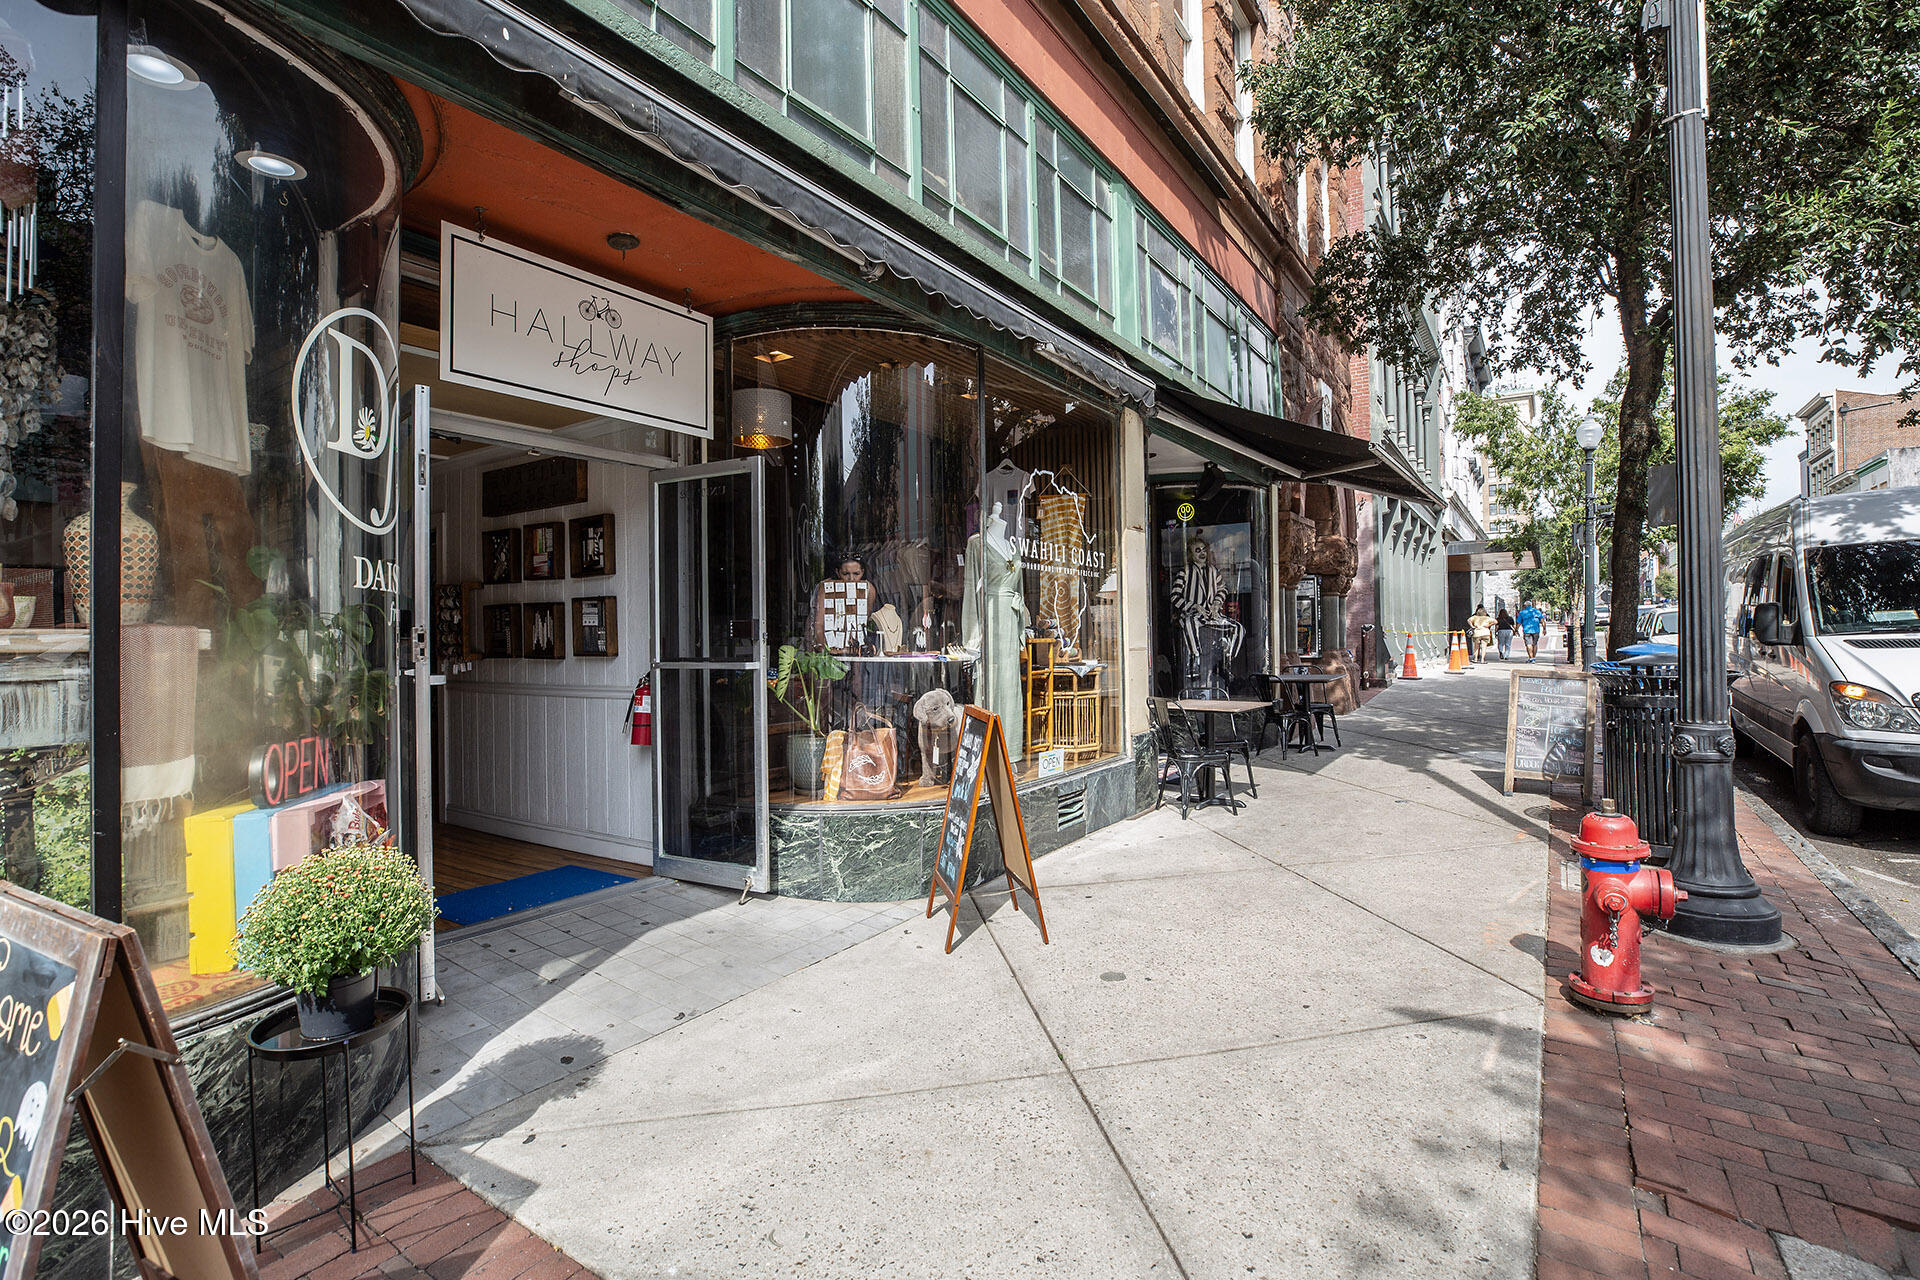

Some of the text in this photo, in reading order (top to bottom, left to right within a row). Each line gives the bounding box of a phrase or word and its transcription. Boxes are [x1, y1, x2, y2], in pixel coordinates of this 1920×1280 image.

[491, 293, 682, 377] HALLWAY
[552, 338, 643, 397] shops
[1009, 535, 1105, 569] SWAHILI COAST
[263, 736, 330, 806] OPEN
[1042, 755, 1061, 770] OPEN
